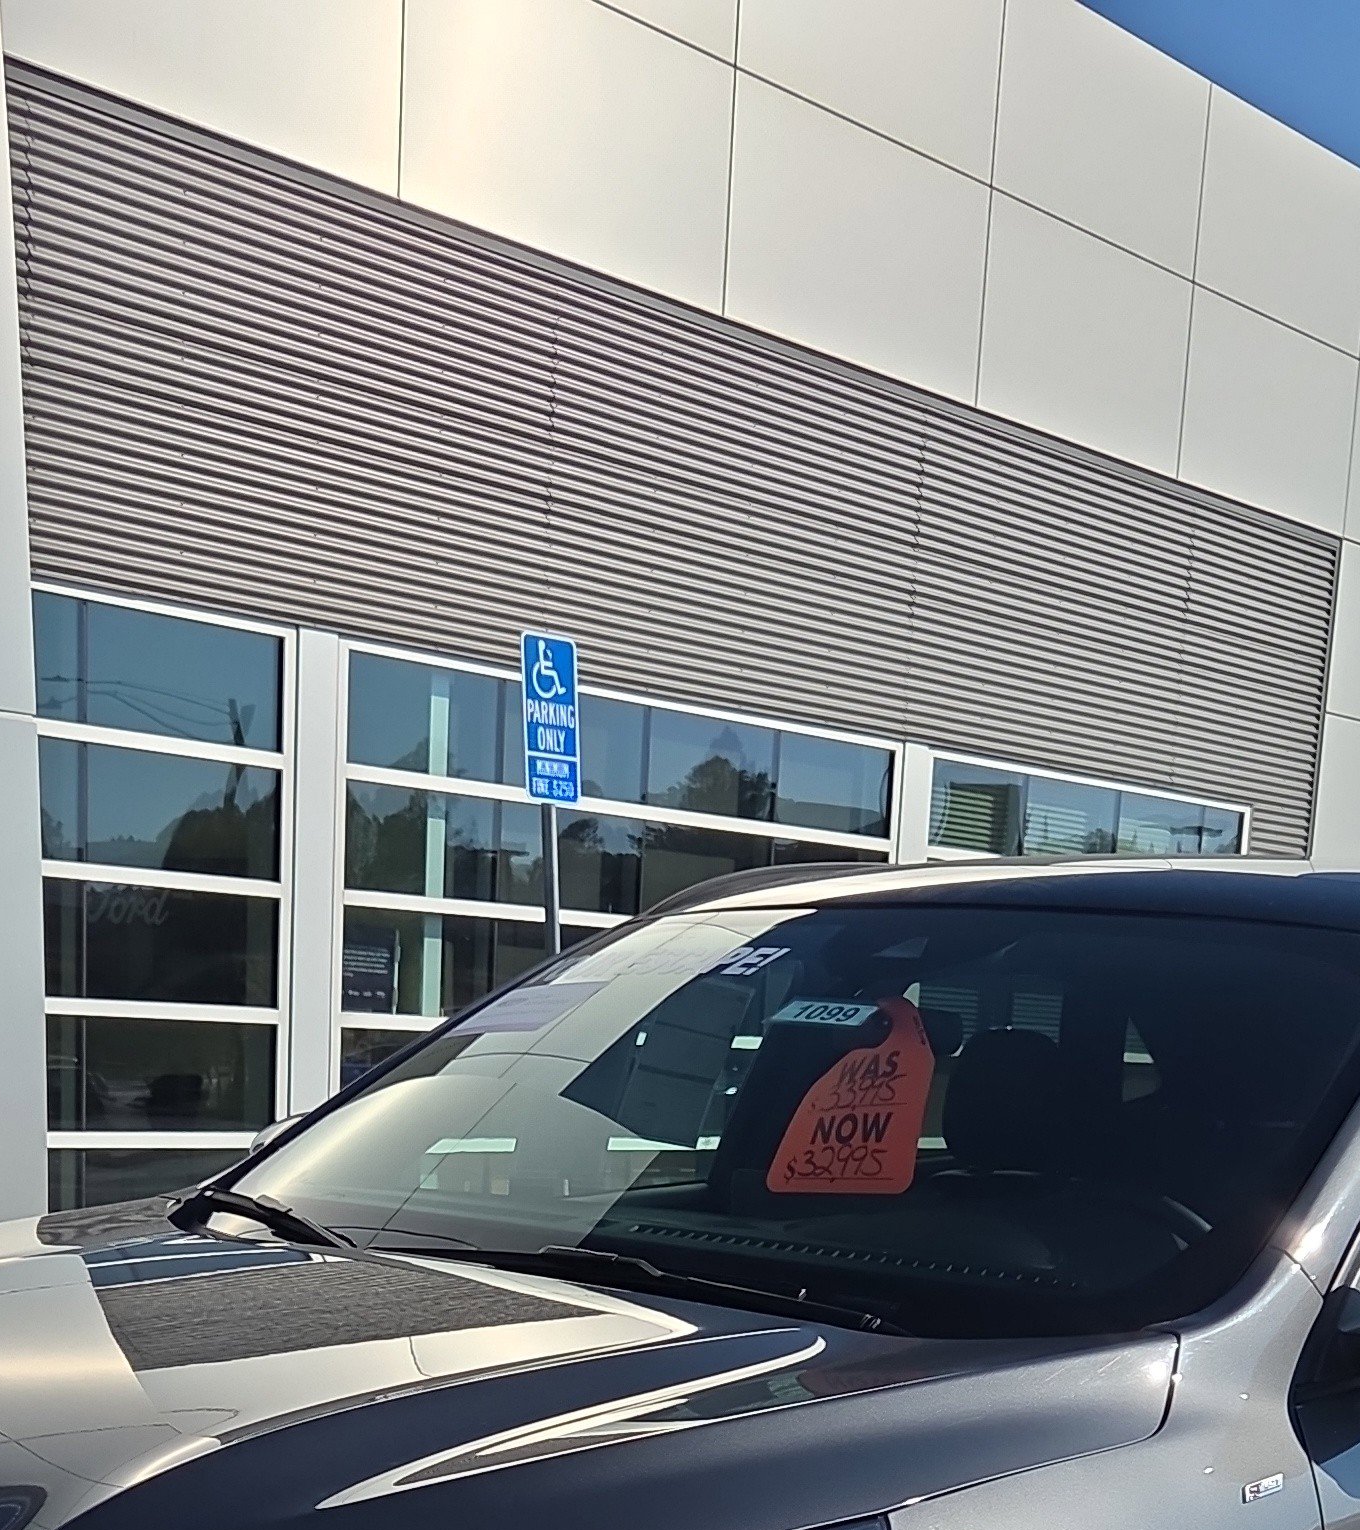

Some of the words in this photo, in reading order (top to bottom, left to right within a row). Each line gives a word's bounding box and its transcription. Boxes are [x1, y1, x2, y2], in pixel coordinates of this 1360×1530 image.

[526, 698, 575, 729] PARKING
[536, 725, 566, 753] ONLY
[793, 1003, 861, 1023] 1099
[836, 1050, 900, 1083] WAS
[810, 1112, 894, 1145] NOW
